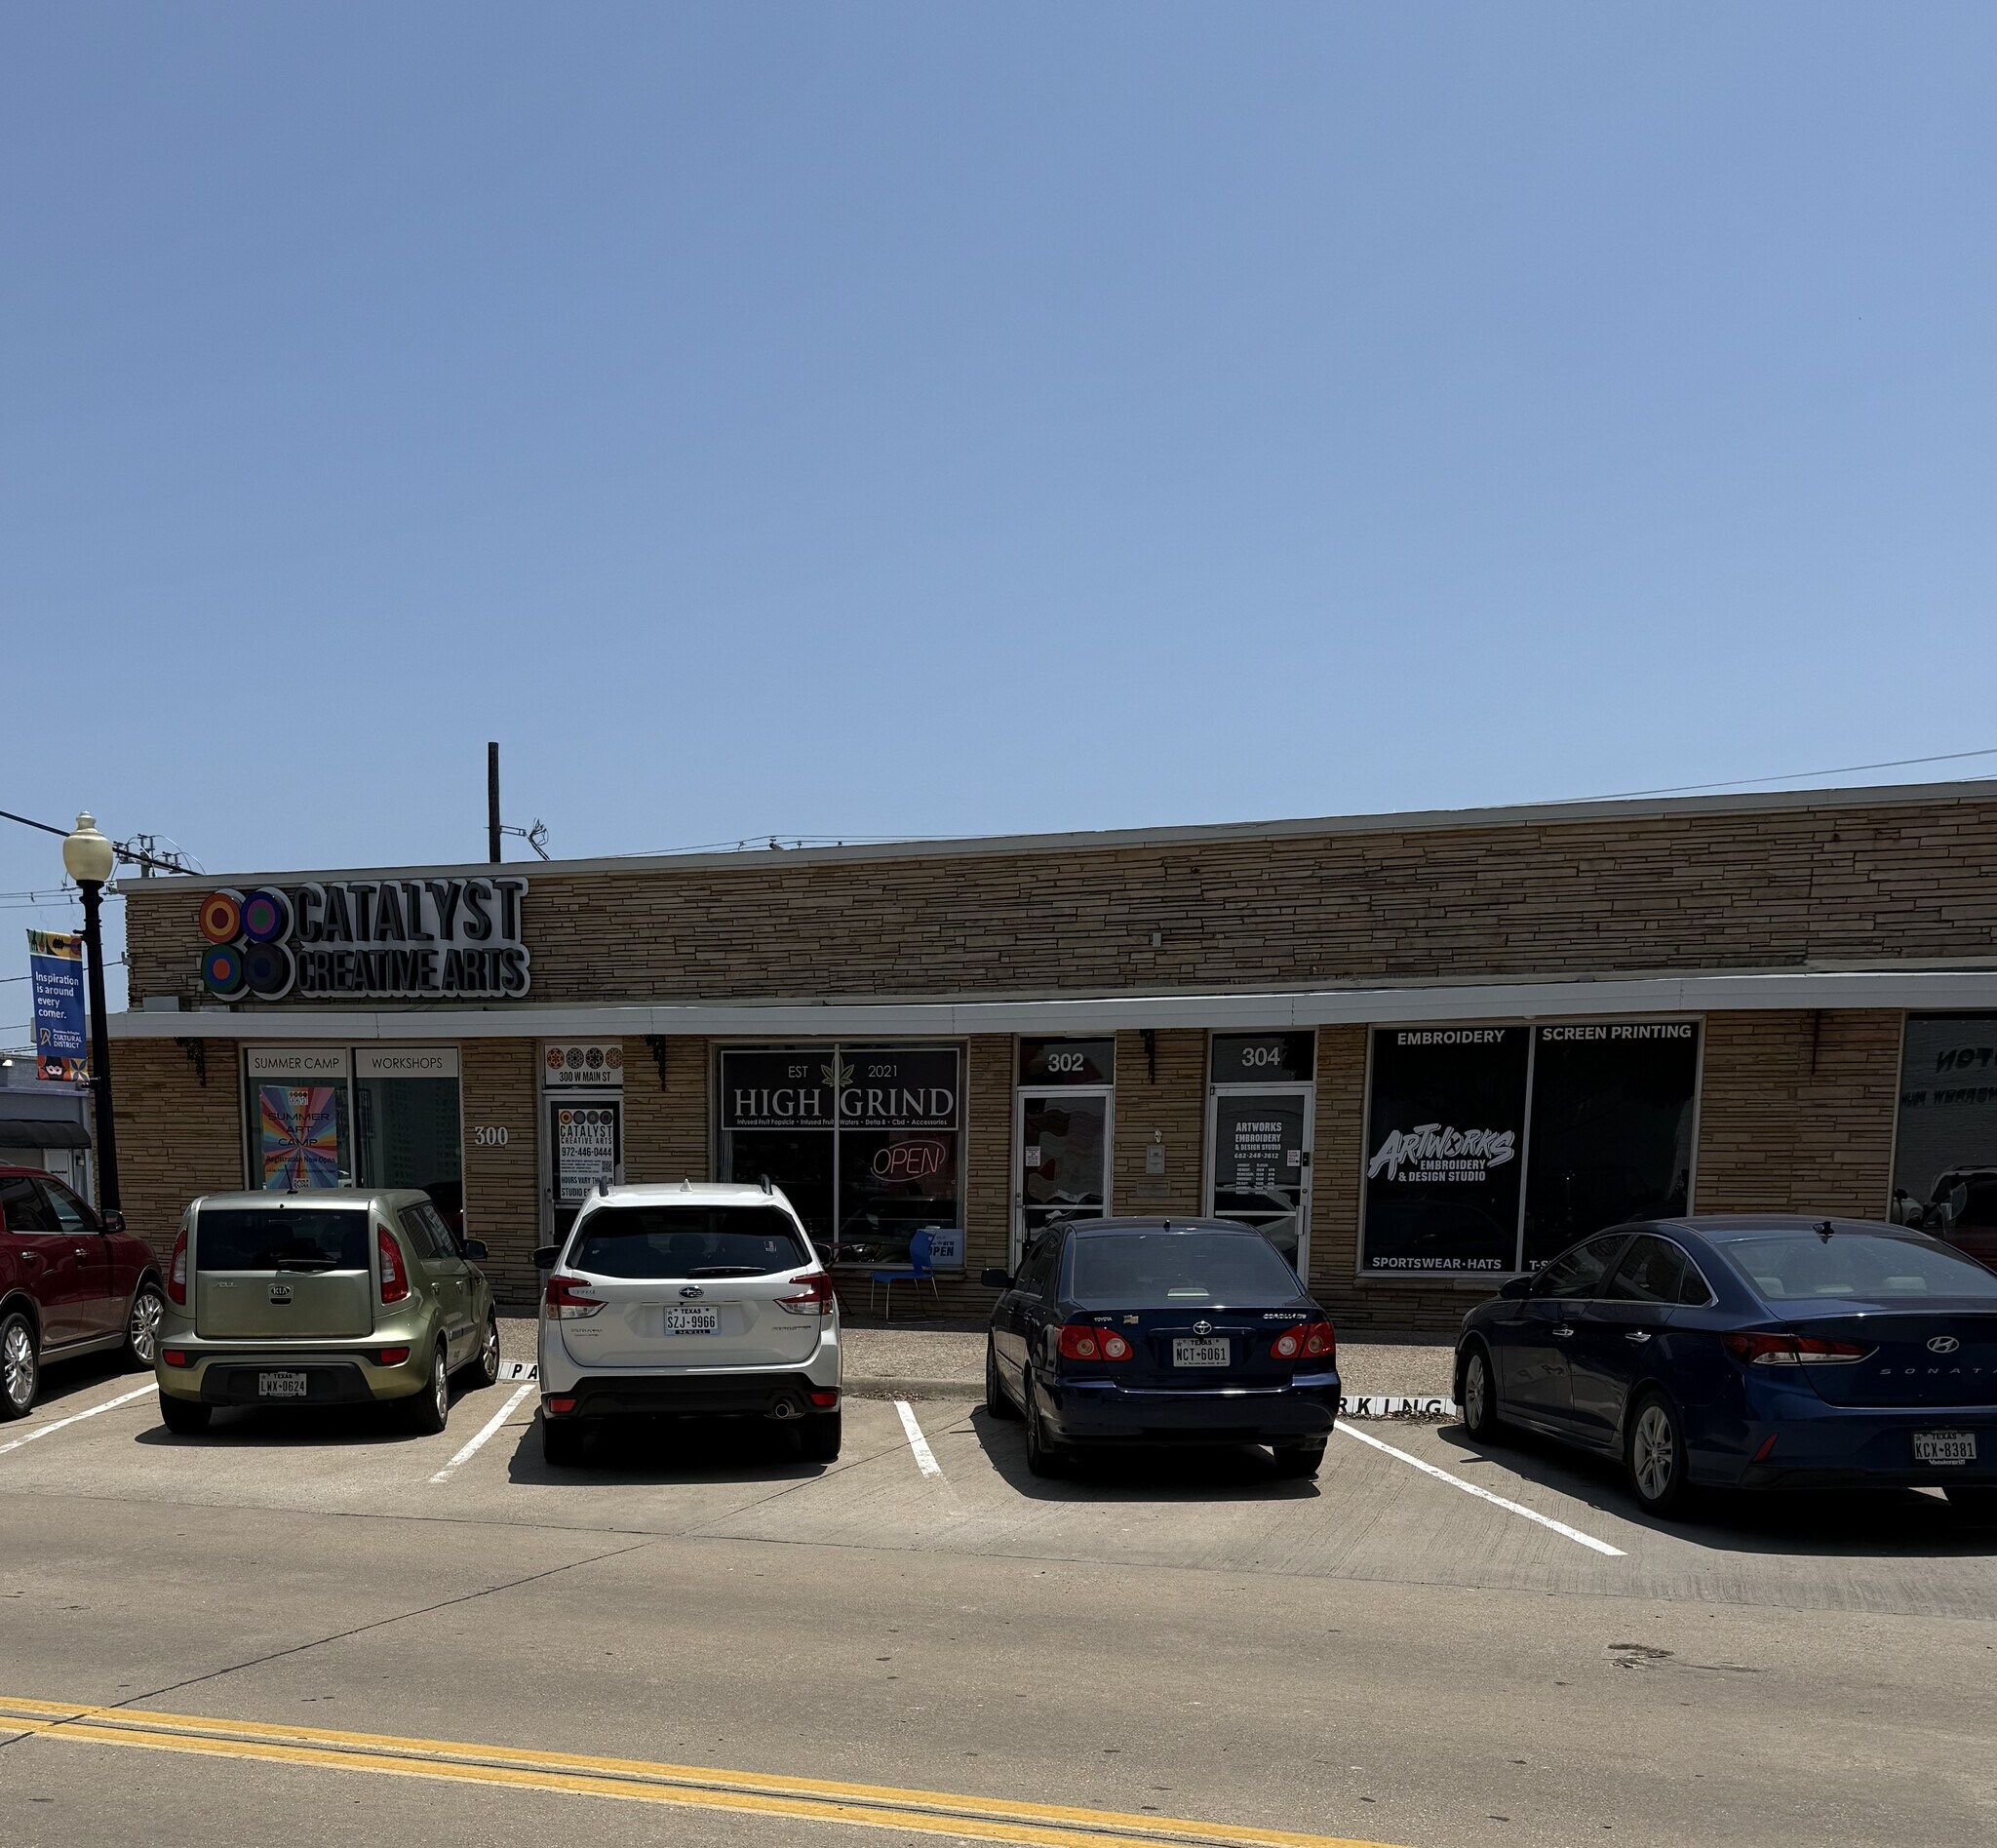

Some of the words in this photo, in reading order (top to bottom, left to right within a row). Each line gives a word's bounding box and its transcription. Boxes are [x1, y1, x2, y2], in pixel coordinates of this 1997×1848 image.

[294, 881, 524, 942] CATALYST
[295, 949, 439, 991] CREATIVE
[443, 948, 526, 991] ARTS
[35, 971, 79, 987] Inspiration
[36, 984, 43, 994] is
[45, 985, 74, 997] around
[38, 997, 59, 1008] every
[38, 1008, 67, 1019] corner.
[54, 1034, 83, 1043] CULTURAL
[1397, 1029, 1506, 1045] EMBROIDERY
[1542, 1026, 1606, 1042] SCREEN
[1611, 1024, 1693, 1040] PRINTING
[54, 1041, 80, 1049] DISTRICT
[1048, 1052, 1084, 1072] 302
[1241, 1046, 1281, 1067] 304
[255, 1057, 301, 1069] SUMMER
[304, 1057, 339, 1069] CAMP
[372, 1057, 443, 1069] WORKSHOPS
[559, 1071, 573, 1082] 300
[574, 1071, 581, 1082] W
[582, 1071, 601, 1082] MAIN
[602, 1071, 611, 1082] ST
[789, 1066, 809, 1079] EST
[868, 1065, 897, 1078] 2021
[734, 1088, 823, 1117] HIGH
[840, 1087, 955, 1117] GRIND
[561, 1125, 612, 1137] CATALYST
[1235, 1121, 1282, 1132] ARTWORKS
[475, 1126, 509, 1146] 300
[1235, 1133, 1281, 1143] EMBROIDERY
[278, 1138, 318, 1147] CAMP
[562, 1147, 612, 1158] 972-446-0444
[874, 1148, 940, 1174] OPEN
[1421, 1160, 1486, 1170] EMBROIDERY
[1398, 1171, 1407, 1182] &
[1408, 1171, 1446, 1182] DESIGN
[1448, 1171, 1486, 1182] STUDIO
[562, 1188, 583, 1197] STUDIO
